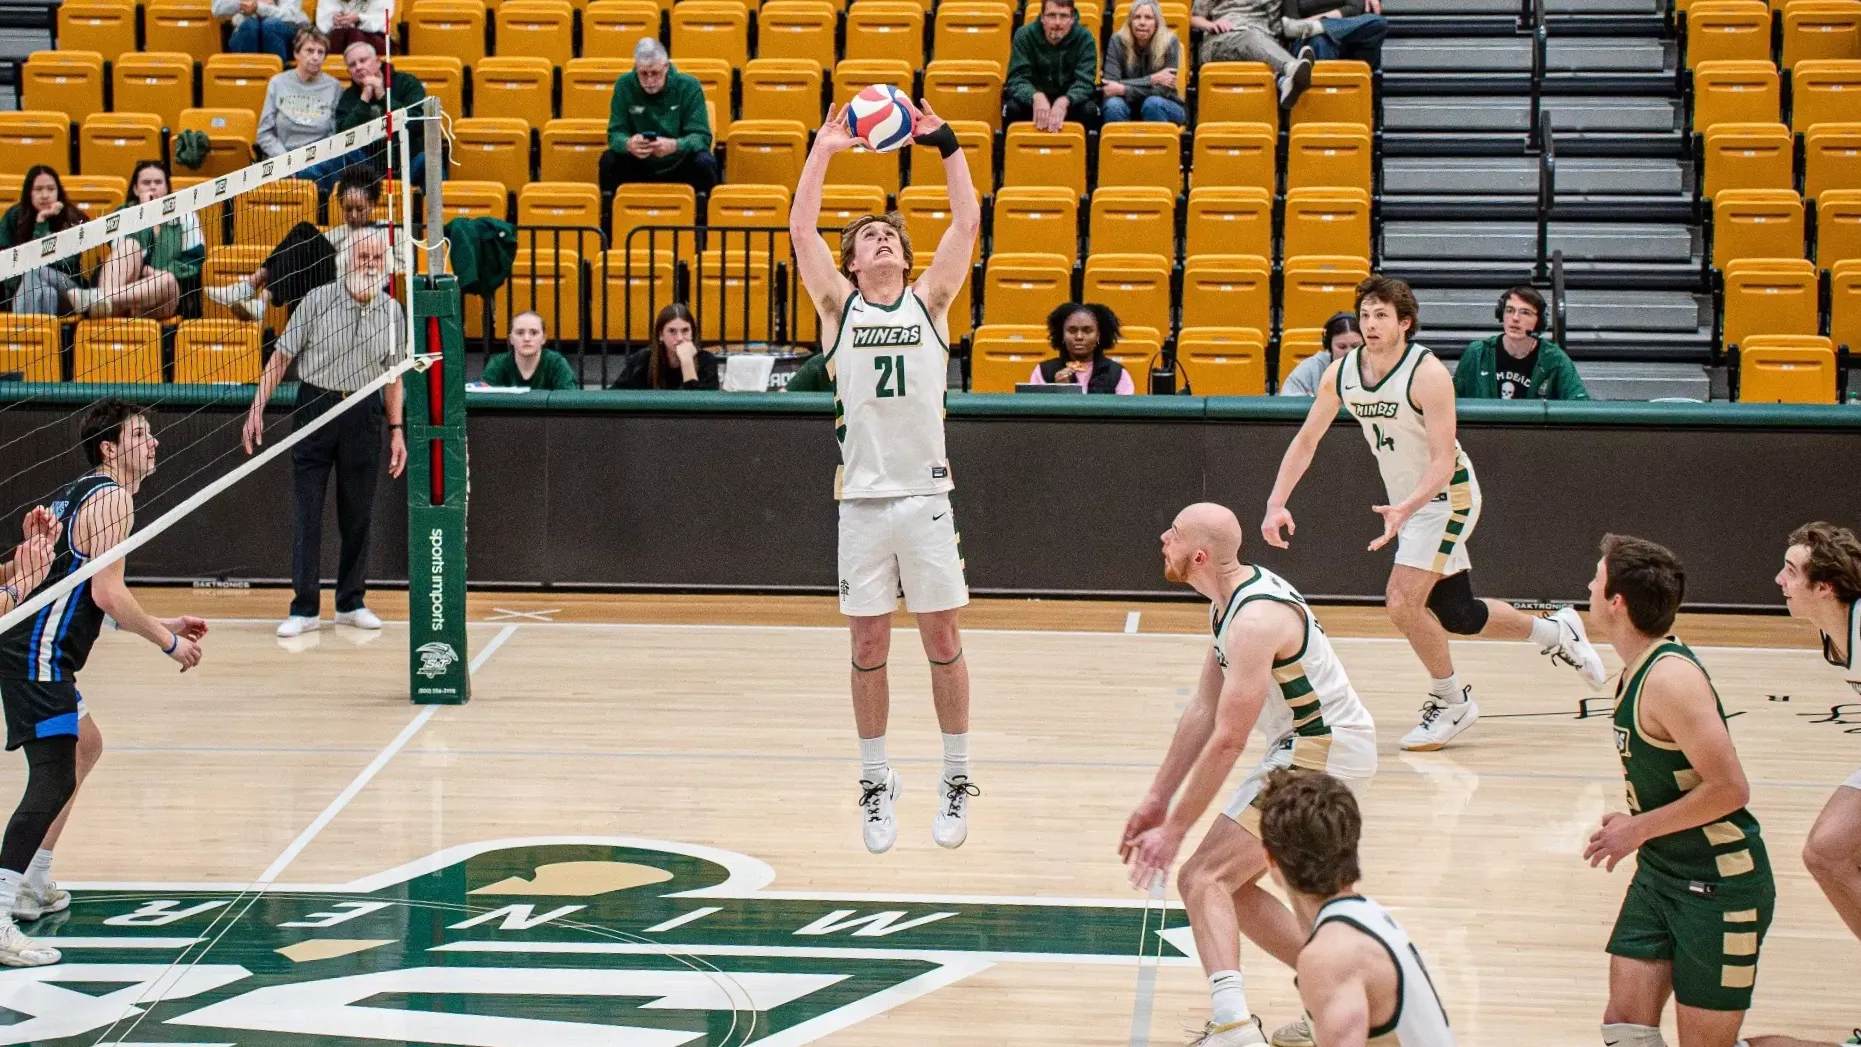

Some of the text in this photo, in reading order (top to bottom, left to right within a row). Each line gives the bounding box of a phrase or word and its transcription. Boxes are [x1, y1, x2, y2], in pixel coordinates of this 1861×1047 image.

[854, 326, 920, 345] MINERS
[874, 355, 906, 397] 21
[1372, 423, 1395, 452] 14
[429, 528, 445, 631] sports imports
[1513, 602, 1574, 610] DAKTRONICS
